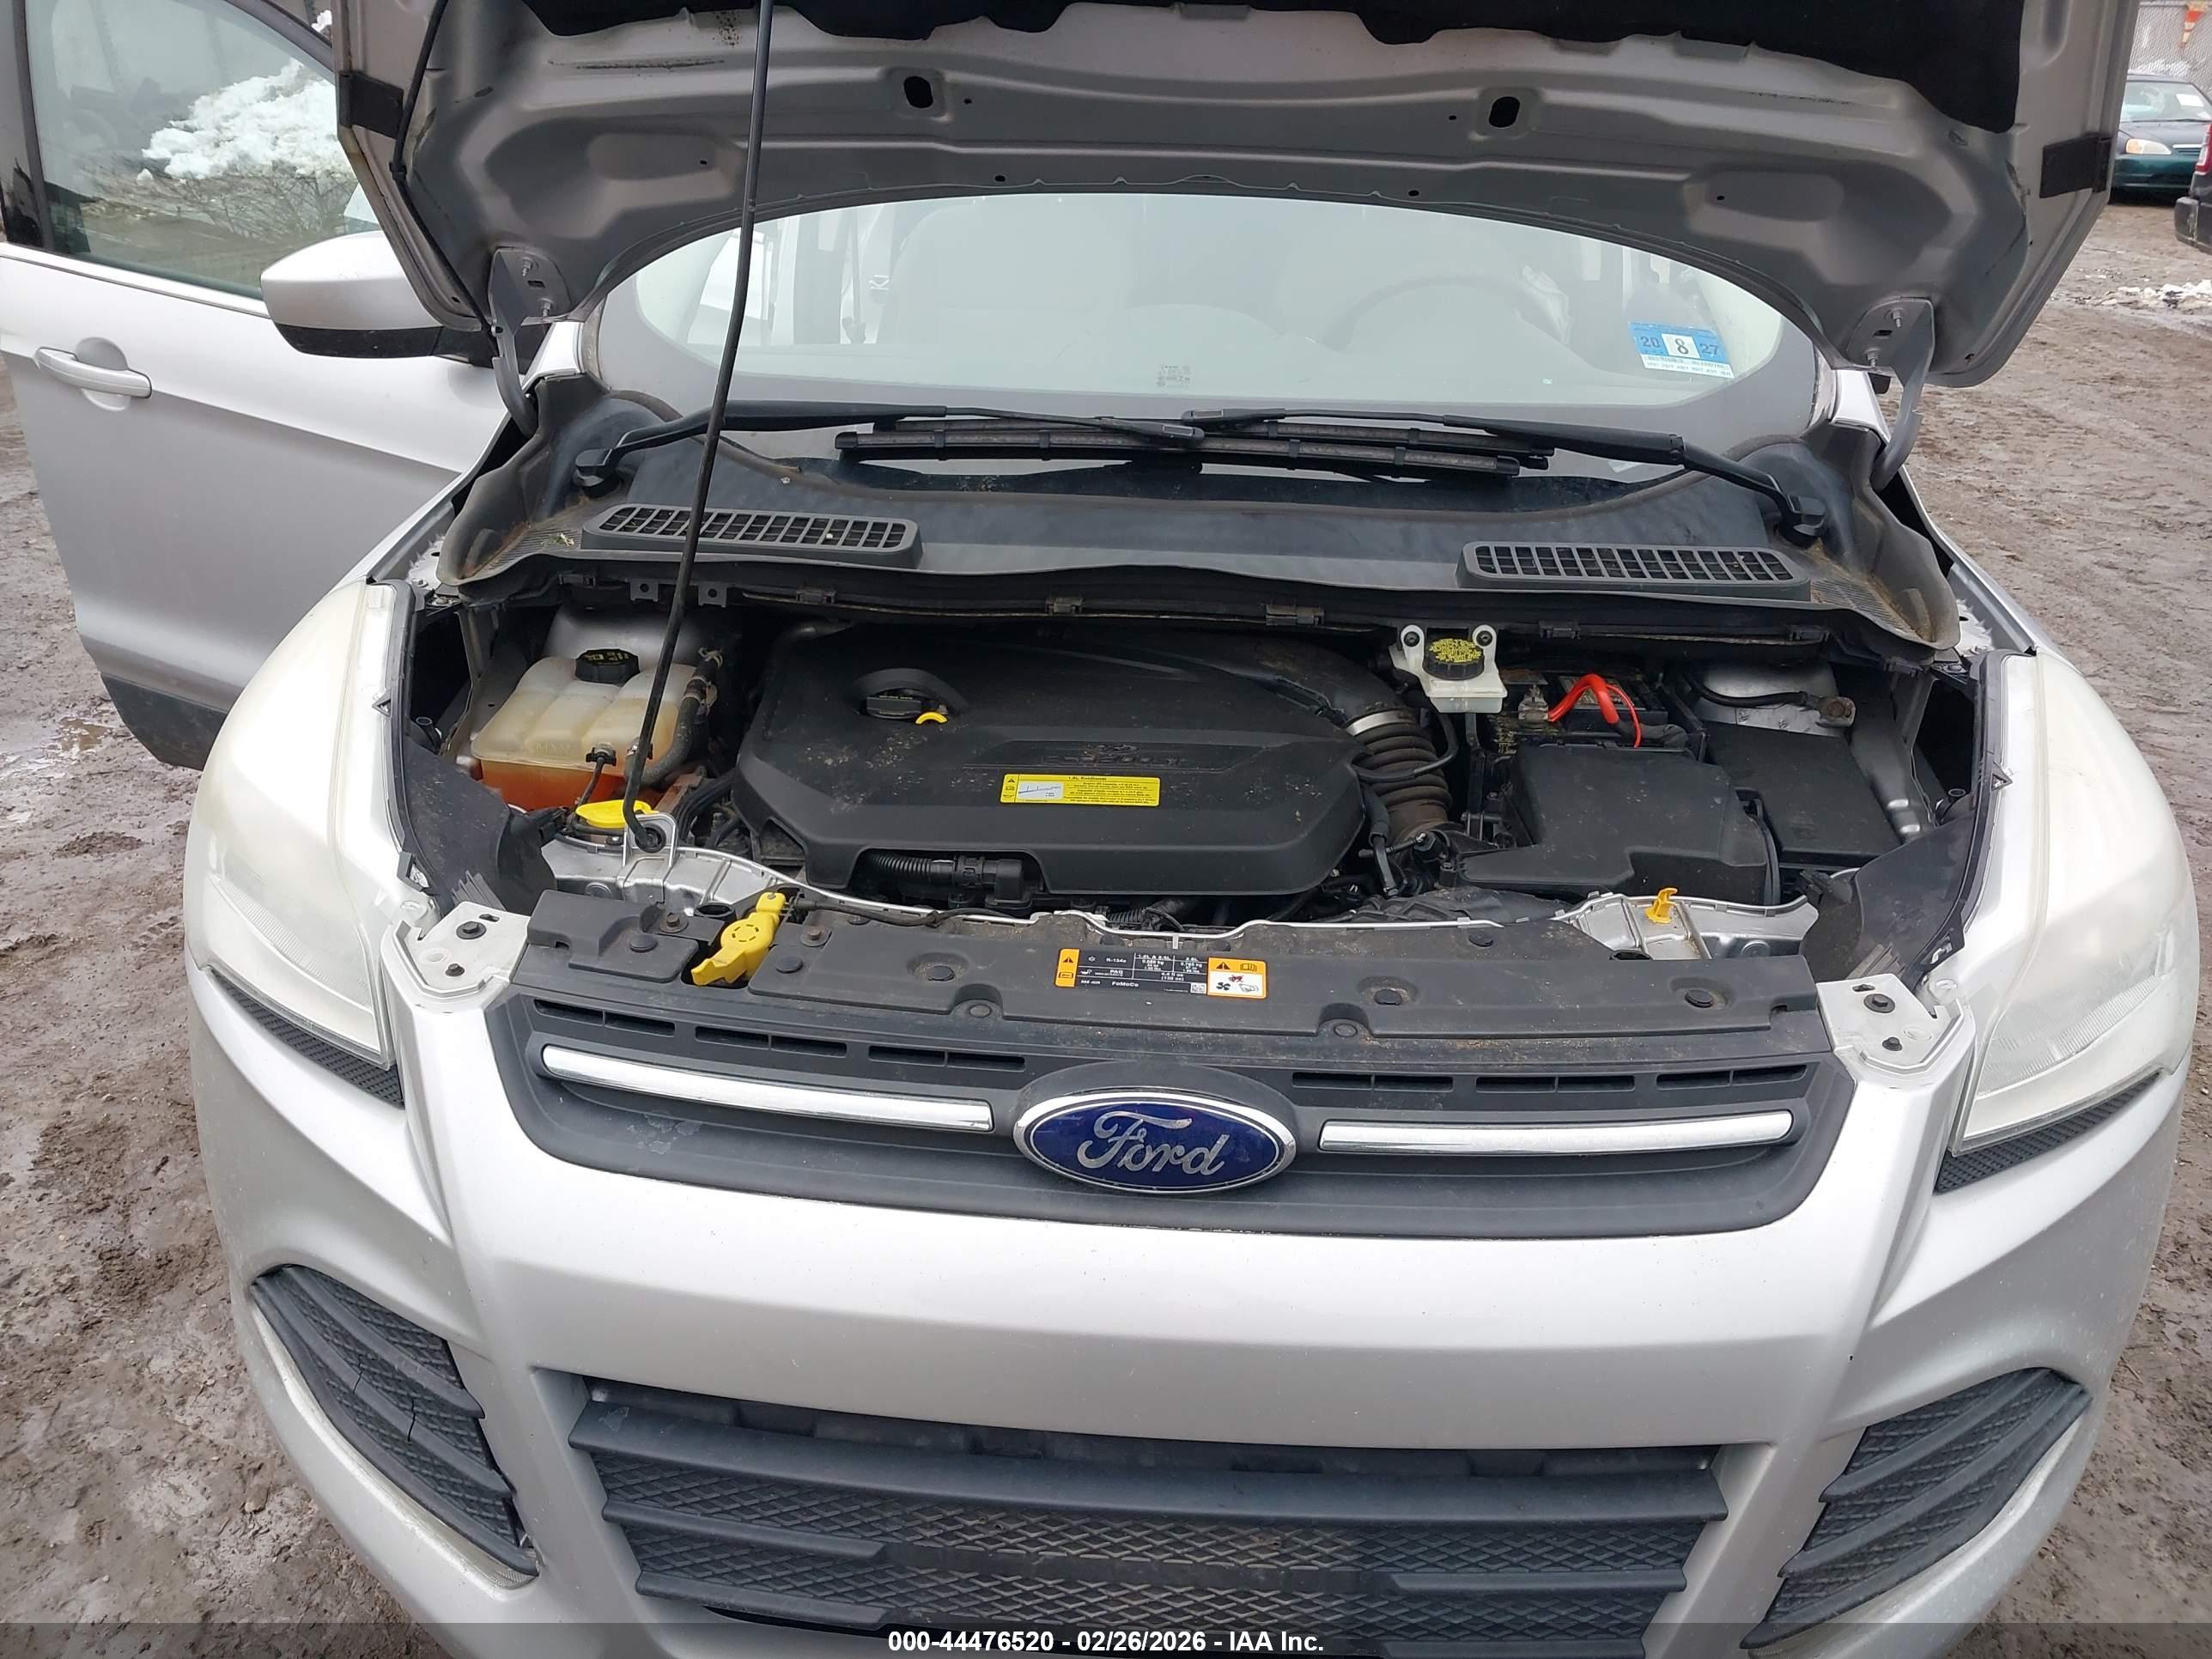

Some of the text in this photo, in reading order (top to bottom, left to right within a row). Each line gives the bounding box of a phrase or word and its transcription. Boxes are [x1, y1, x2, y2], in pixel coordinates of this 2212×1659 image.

[1640, 336, 1719, 356] 20 8 27
[1077, 1110, 1231, 1176] Ford
